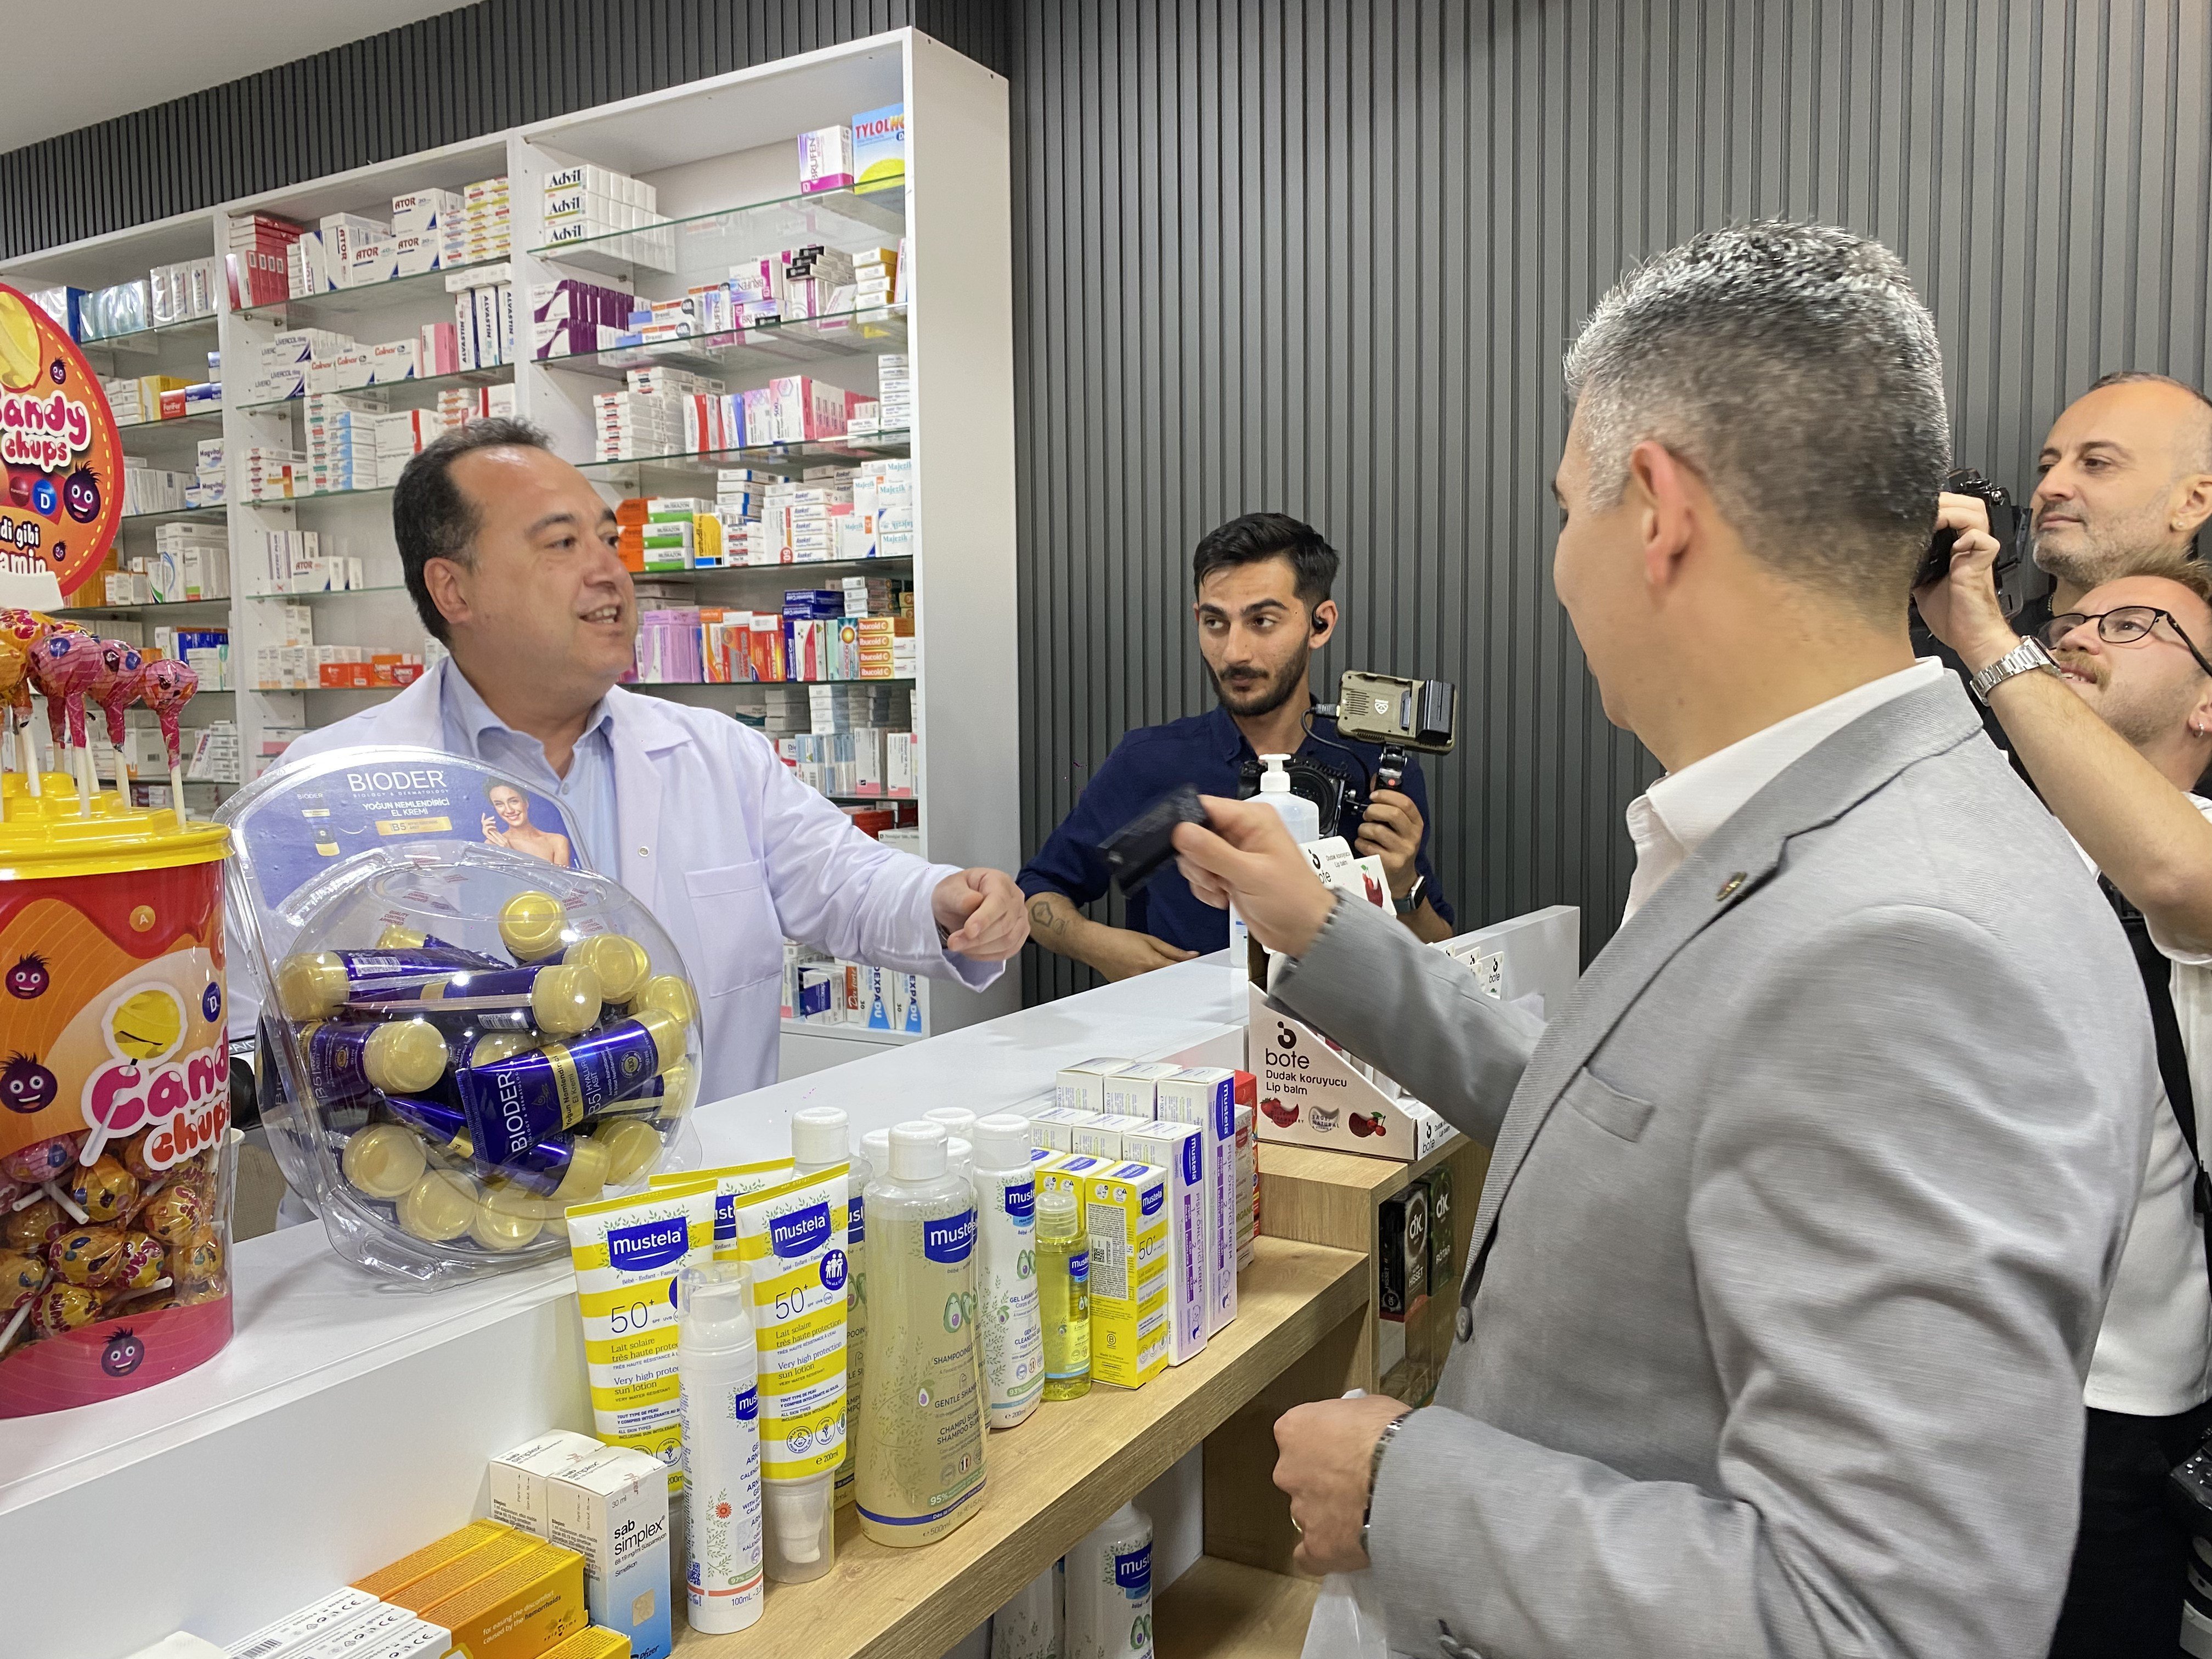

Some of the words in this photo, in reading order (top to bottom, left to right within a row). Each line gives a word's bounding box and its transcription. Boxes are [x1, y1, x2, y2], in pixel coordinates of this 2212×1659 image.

[809, 137, 819, 182] BRUFEN
[549, 169, 580, 188] Advil
[394, 197, 416, 210] ATOR
[549, 196, 580, 215] Advil
[550, 224, 582, 242] Advil
[339, 228, 347, 262] ATOR
[398, 237, 419, 249] ATOR
[356, 246, 379, 260] ATOR
[0, 396, 86, 446] andy
[5, 430, 67, 466] chups
[880, 485, 905, 493] Majezik
[40, 493, 50, 509] D
[16, 523, 38, 548] gibi
[883, 534, 907, 543] Majezik
[296, 561, 313, 570] ATOR
[347, 770, 447, 792] BIODER
[363, 800, 393, 811] YOĞUN
[1318, 869, 1331, 884] ote
[139, 913, 149, 925] A
[1489, 971, 1500, 984] bote
[208, 996, 218, 1012] D
[1265, 1048, 1310, 1069] bote
[1266, 1070, 1296, 1082] Dudak
[1300, 1075, 1347, 1088] koruyucu
[1266, 1082, 1280, 1093] Lip
[1283, 1084, 1307, 1096] balm
[497, 1071, 528, 1153] BIODER
[1423, 1138, 1435, 1154] bote
[639, 1273, 656, 1281] Enfant
[661, 1268, 680, 1277] Famille
[776, 1328, 789, 1339] Lait
[791, 1321, 811, 1335] solaire
[776, 1338, 791, 1348] très
[792, 1331, 811, 1344] haute
[812, 1319, 842, 1337] protection
[611, 1344, 627, 1353] Lait
[630, 1338, 655, 1350] solaire
[612, 1352, 628, 1362] très
[631, 1348, 653, 1359] haute
[778, 1359, 795, 1370] Very
[797, 1351, 812, 1364] high
[813, 1341, 842, 1359] protection
[614, 1375, 633, 1386] Very
[636, 1369, 653, 1382] high
[778, 1371, 793, 1380] sun
[794, 1363, 815, 1375] lotion
[614, 1387, 630, 1395] sun
[633, 1381, 657, 1392] lotion
[935, 1393, 960, 1408] GENTLE
[937, 1425, 968, 1445] SHAMPOO
[614, 1519, 635, 1540] sab
[614, 1520, 663, 1556] simplex
[615, 1560, 637, 1577] Simetikon
[483, 1627, 492, 1635] for
[493, 1613, 513, 1630] easing
[513, 1609, 523, 1618] the
[524, 1590, 554, 1611] discomfort
[483, 1627, 504, 1645] caused
[505, 1623, 513, 1632] by
[514, 1617, 524, 1627] the
[524, 1594, 561, 1620] hemorrhoids
